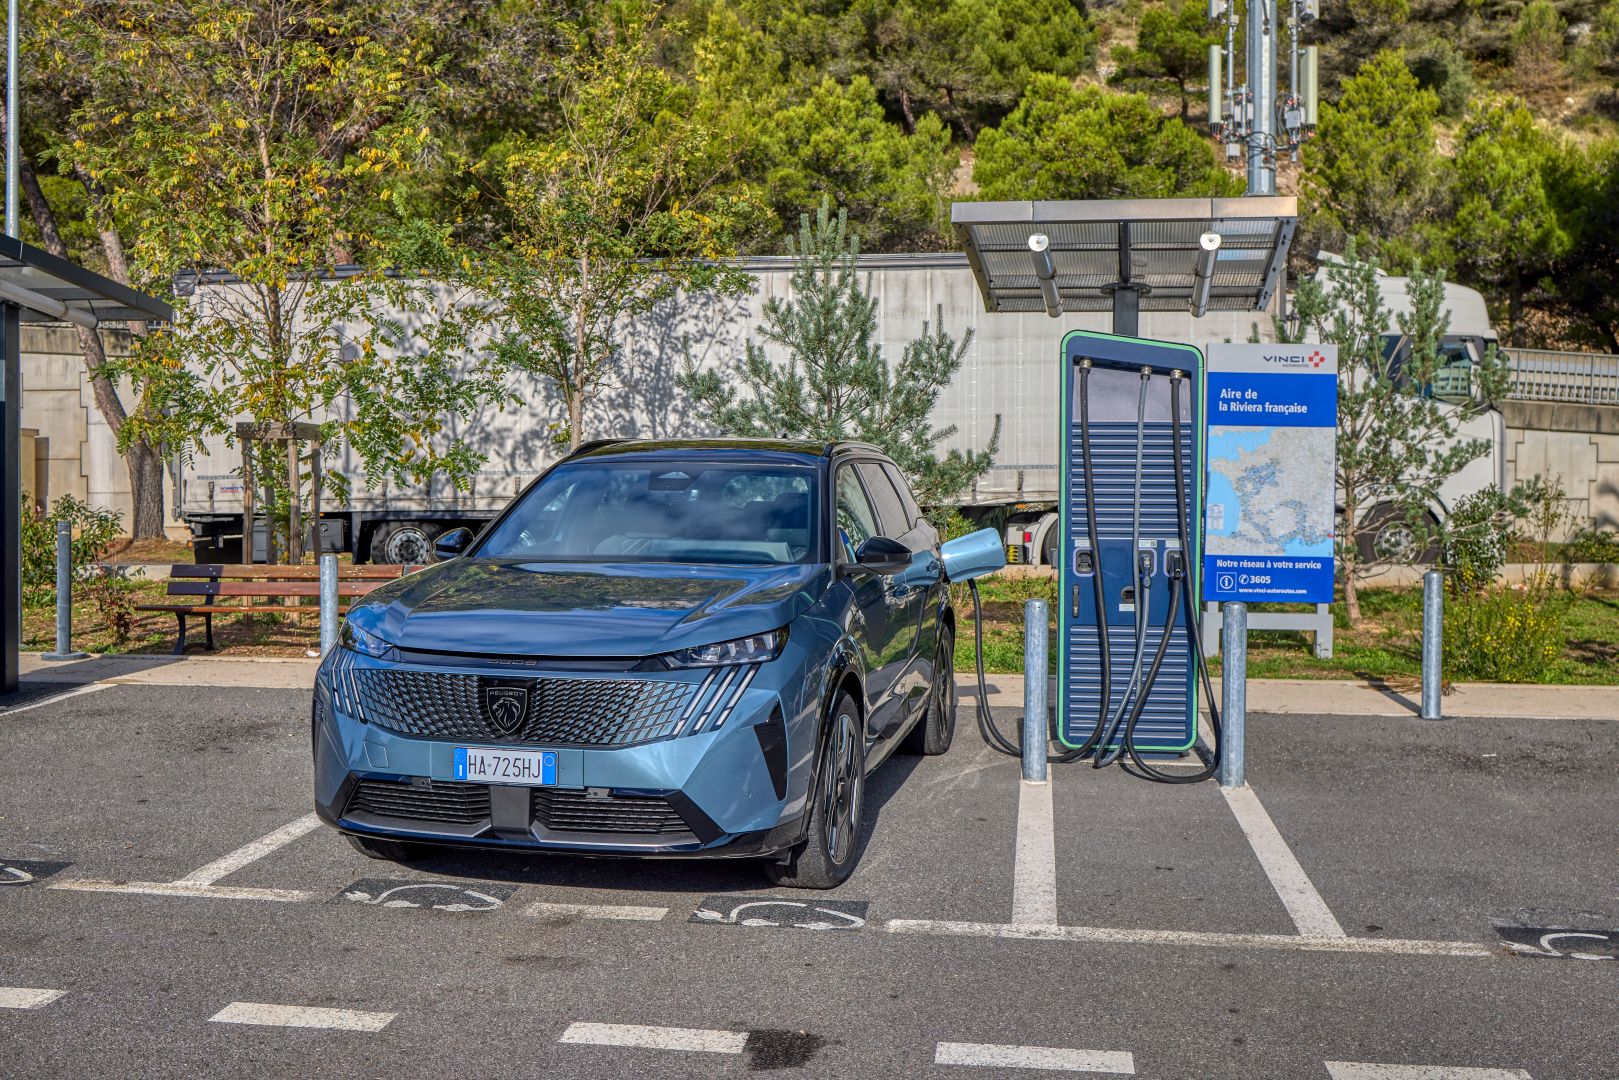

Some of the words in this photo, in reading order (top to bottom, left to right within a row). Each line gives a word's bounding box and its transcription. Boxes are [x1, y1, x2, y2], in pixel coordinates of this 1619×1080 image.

[1220, 388, 1242, 399] Aire
[1244, 388, 1258, 400] de
[1219, 401, 1228, 412] la
[1230, 401, 1263, 413] Riviera
[1265, 402, 1308, 415] française
[1216, 559, 1238, 568] Notre
[1239, 559, 1265, 569] réseau
[1266, 559, 1272, 569] à
[1273, 560, 1294, 569] votre
[1295, 560, 1322, 570] service
[1249, 575, 1271, 584] 3605
